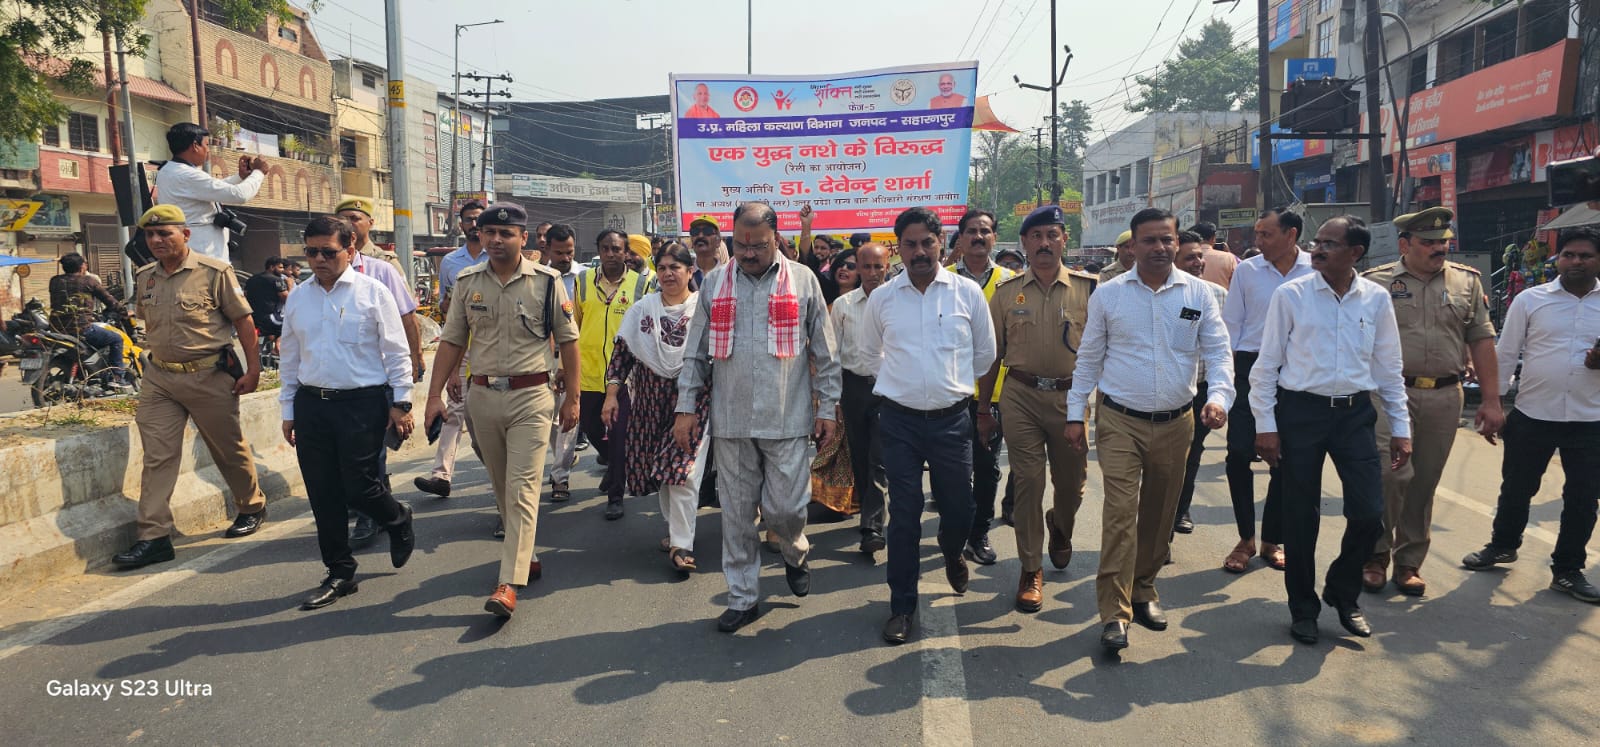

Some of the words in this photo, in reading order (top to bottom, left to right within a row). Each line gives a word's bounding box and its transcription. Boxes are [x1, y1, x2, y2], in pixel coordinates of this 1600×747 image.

[697, 123, 722, 134] उ.प्र.
[725, 120, 761, 133] महिला
[763, 121, 804, 131] कल्याण
[807, 117, 843, 129] विभाग
[849, 117, 887, 128] जनपद
[901, 113, 956, 128] सहारनपुर
[708, 146, 747, 162] एक
[752, 145, 794, 167] युद्ध
[798, 139, 838, 158] नशे
[843, 138, 868, 157] के
[809, 164, 821, 172] का
[825, 160, 867, 173] आयोजन)
[548, 183, 585, 195] अनिका
[721, 186, 741, 197] मुख्य
[745, 184, 774, 194] अतिथि
[780, 180, 811, 196] डा.
[818, 174, 879, 195] देवेन्द्र
[884, 170, 933, 192] शर्मा
[834, 197, 851, 205] राज्य
